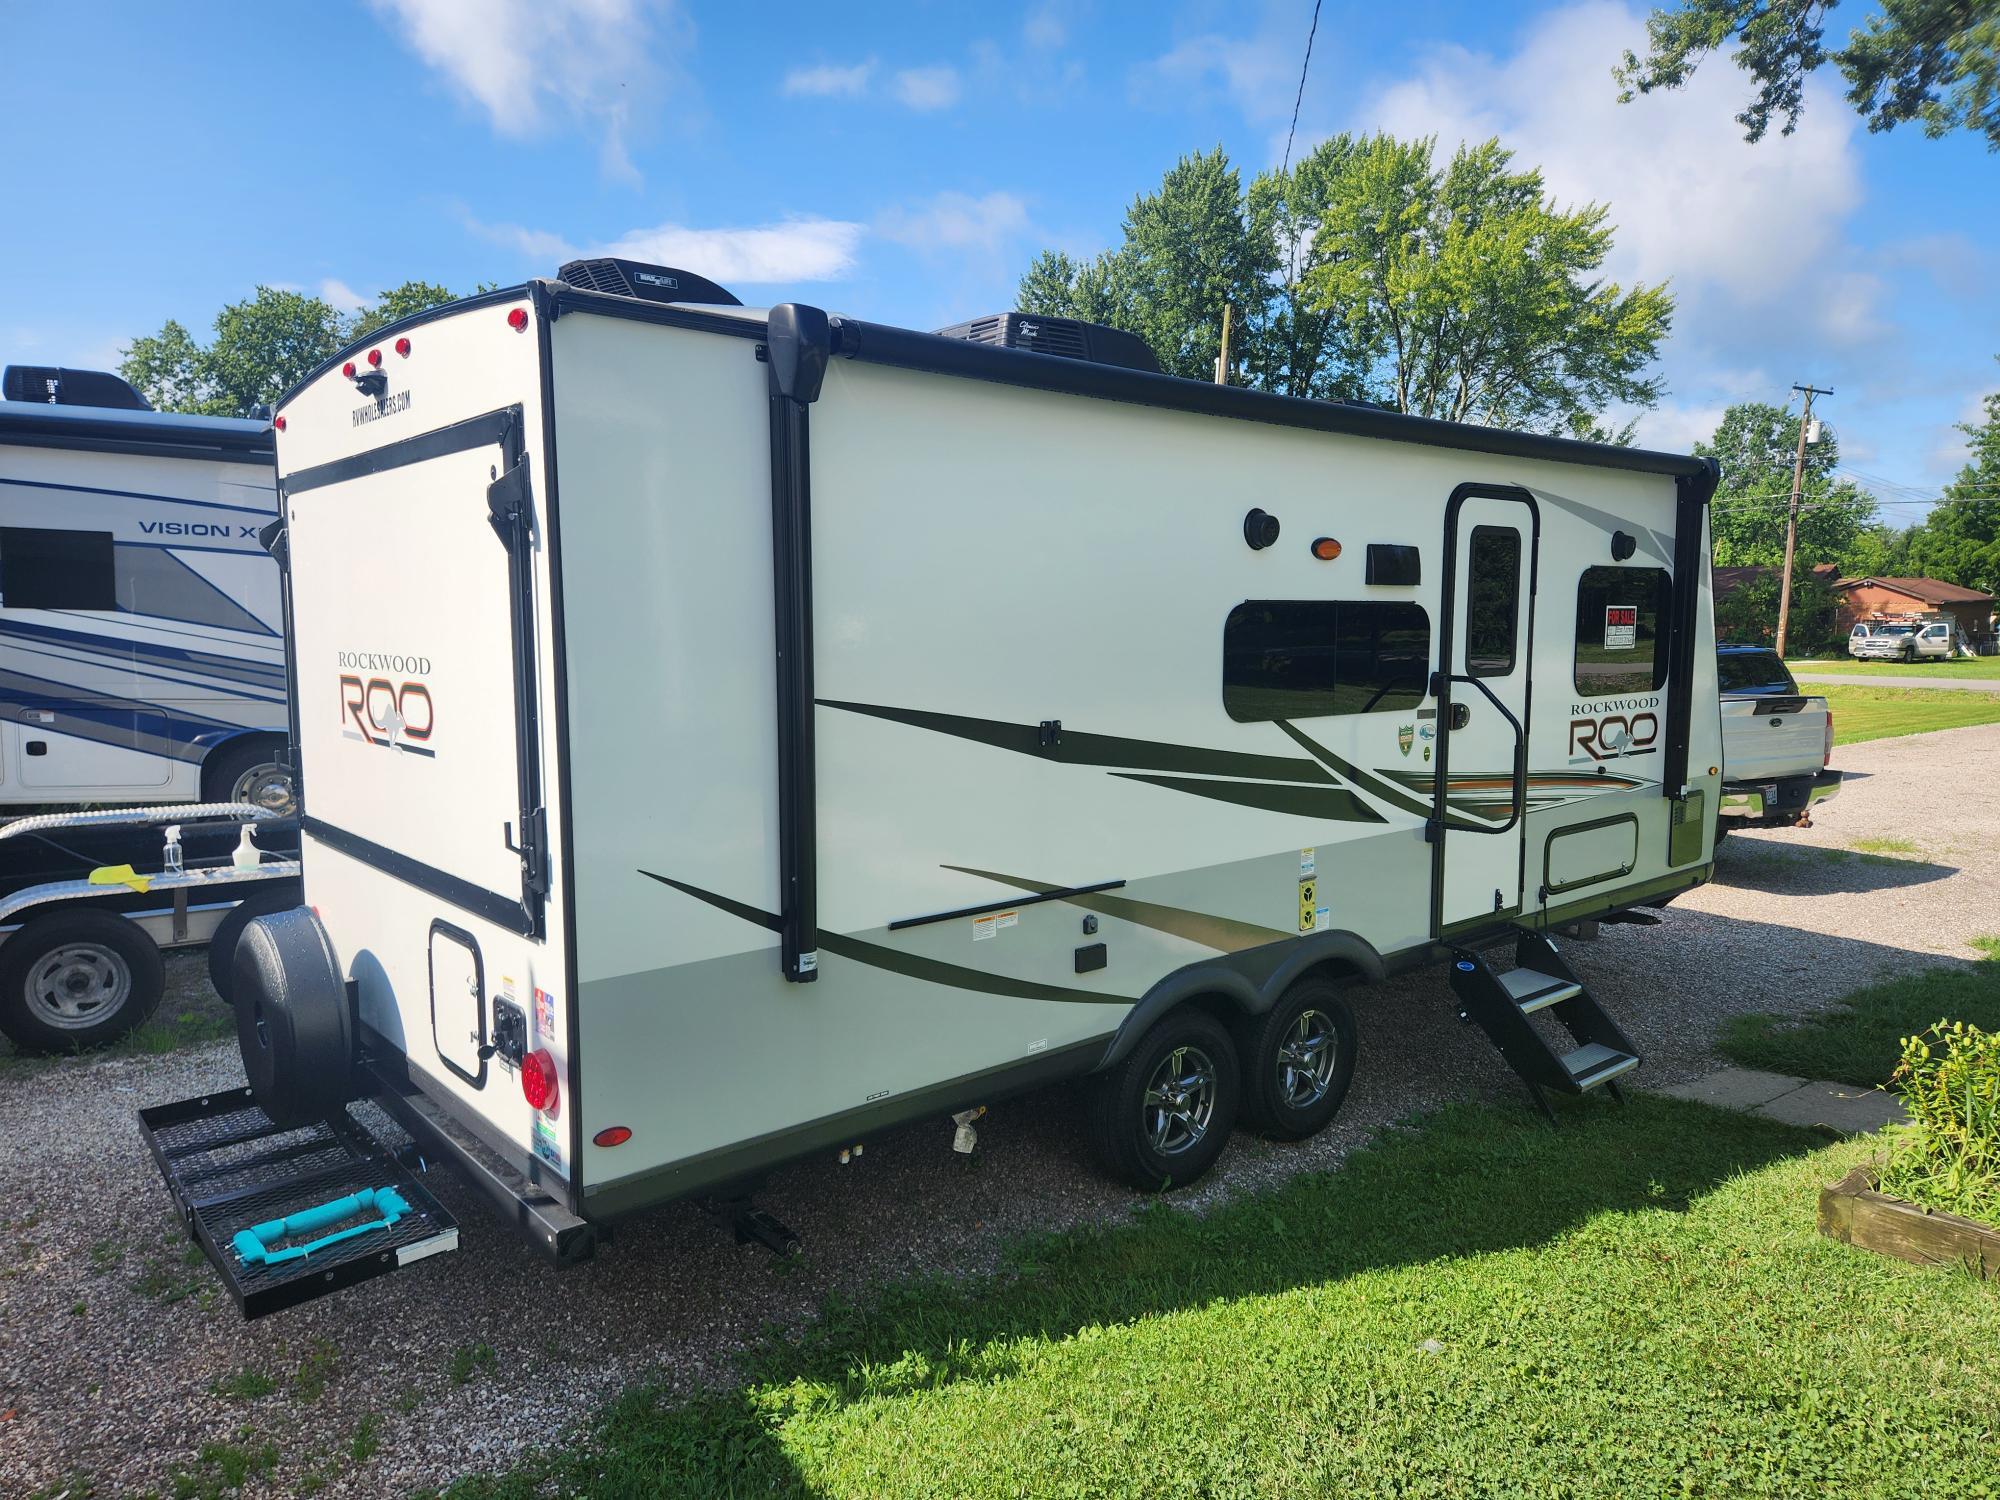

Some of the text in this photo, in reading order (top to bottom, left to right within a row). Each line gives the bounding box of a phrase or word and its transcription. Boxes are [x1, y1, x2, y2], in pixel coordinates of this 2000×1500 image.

[138, 521, 262, 539] VISION X
[1608, 609, 1635, 625] FOR SALE
[338, 651, 431, 675] ROCKWOOD
[339, 674, 434, 744] ROO
[1570, 697, 1660, 715] ROCKWOOD
[1568, 712, 1658, 761] ROO
